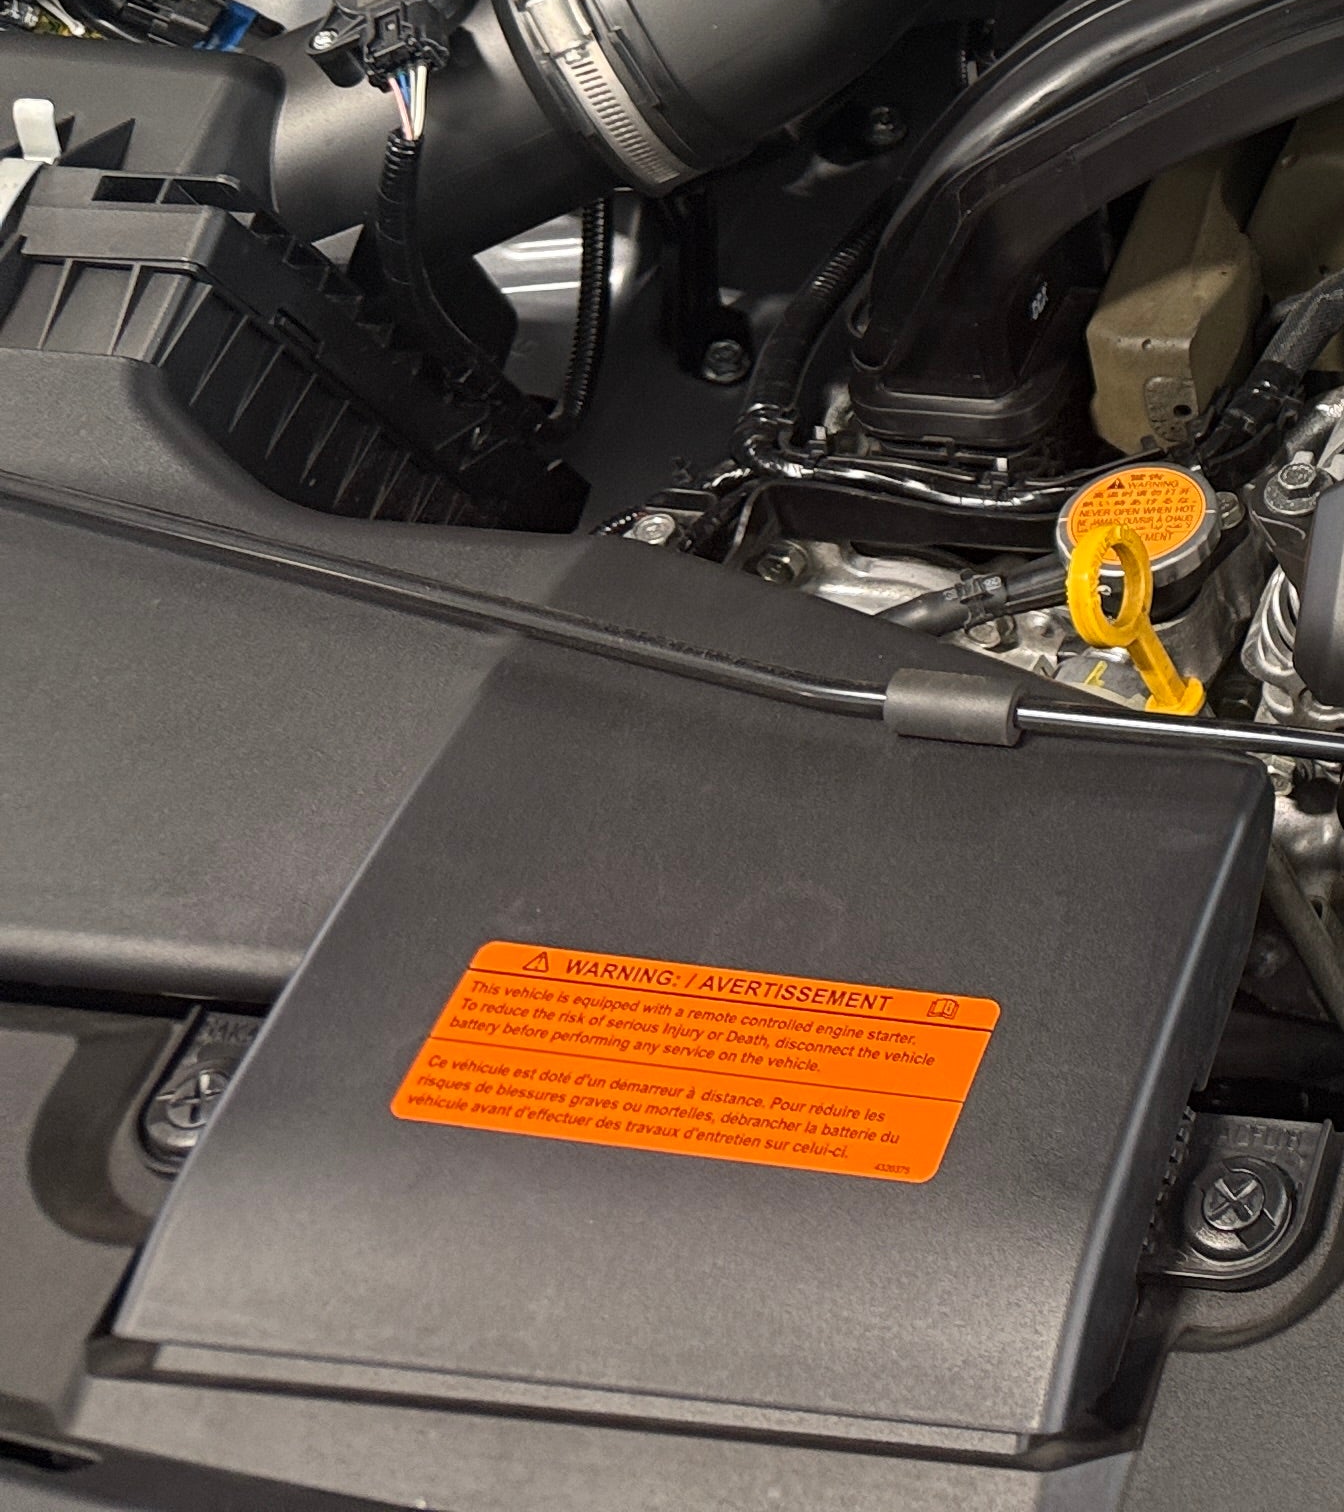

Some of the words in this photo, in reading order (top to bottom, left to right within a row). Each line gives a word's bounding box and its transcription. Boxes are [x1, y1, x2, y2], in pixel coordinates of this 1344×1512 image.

[471, 980, 501, 995] This
[504, 986, 554, 1002] vehicle
[572, 995, 641, 1012] equipped
[642, 1003, 672, 1016] with
[686, 1009, 737, 1024] remote
[740, 1015, 814, 1033] controlled
[815, 1024, 864, 1039] engine
[866, 1030, 915, 1045] starter.
[566, 958, 681, 987] WARNING:
[698, 975, 894, 1011] AVERTISSEMENT
[449, 1015, 501, 1036] battery
[502, 1022, 549, 1039] before
[549, 1031, 631, 1052] performing
[633, 1040, 661, 1055] any
[662, 1044, 715, 1059] service
[740, 1051, 764, 1065] the
[767, 1056, 820, 1072] vehicle.
[461, 997, 478, 1011] To
[479, 1003, 530, 1018] reduce
[532, 1007, 556, 1021] the
[558, 1010, 585, 1024] risk
[605, 1018, 659, 1033] serious
[662, 1022, 705, 1042] Injury
[725, 1029, 770, 1049] Death,
[774, 1037, 855, 1057] disconnect
[857, 1046, 880, 1060] the
[884, 1051, 935, 1066] vehicle
[416, 1074, 471, 1091] risques
[495, 1083, 567, 1103] blessures
[568, 1095, 619, 1110] graves
[644, 1104, 715, 1124] mortelles,
[803, 1120, 818, 1134] la
[820, 1123, 877, 1141] batterie
[880, 1130, 900, 1144] du
[427, 1054, 448, 1069] Ce
[512, 1068, 537, 1080] est
[573, 1073, 606, 1088] d'un
[700, 1089, 765, 1108] distance.
[769, 1096, 807, 1112] Pour
[863, 1108, 886, 1122] les
[470, 1102, 513, 1117] avant
[514, 1105, 593, 1126] d'effectuer
[594, 1116, 622, 1131] des
[625, 1120, 680, 1138] travaux
[683, 1127, 761, 1147] d'entretien
[763, 1139, 791, 1151] sur
[792, 1141, 848, 1158] celui-ci.
